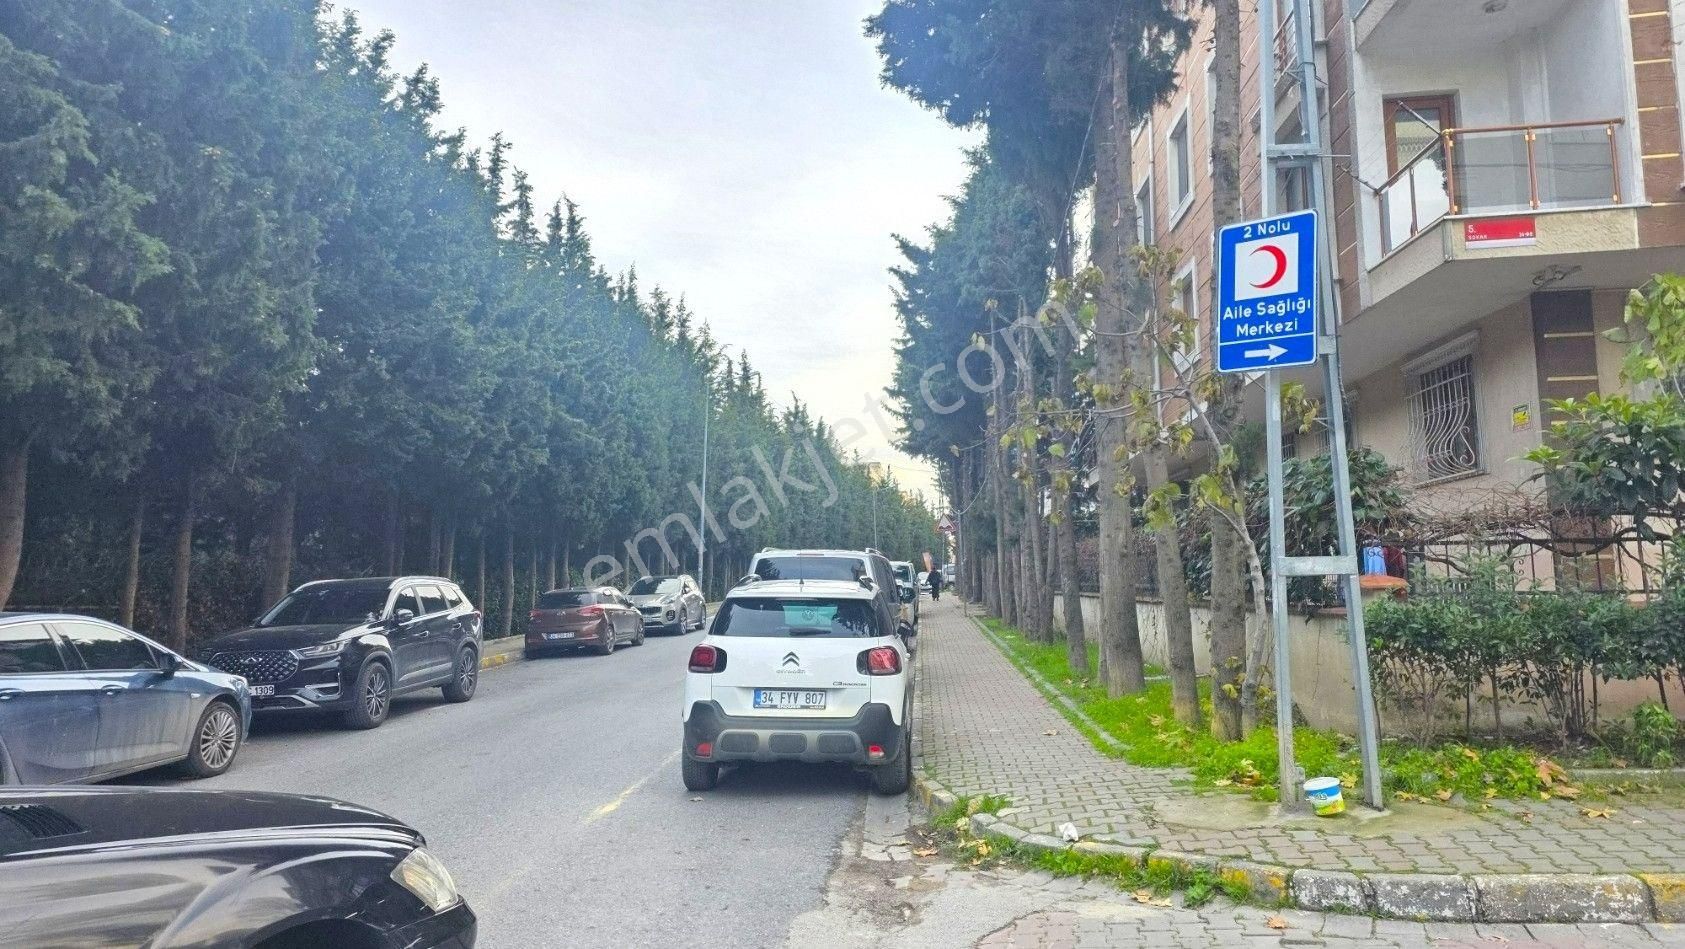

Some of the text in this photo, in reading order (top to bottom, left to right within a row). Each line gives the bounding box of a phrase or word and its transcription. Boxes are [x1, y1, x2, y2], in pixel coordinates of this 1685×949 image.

[1243, 220, 1291, 239] 2 Nolu
[1468, 224, 1476, 233] 5.
[1223, 297, 1311, 320] Aile Sağlığı
[1236, 317, 1299, 337] Merkezi
[255, 685, 274, 695] 1309
[761, 692, 824, 705] 34 FYV 807
